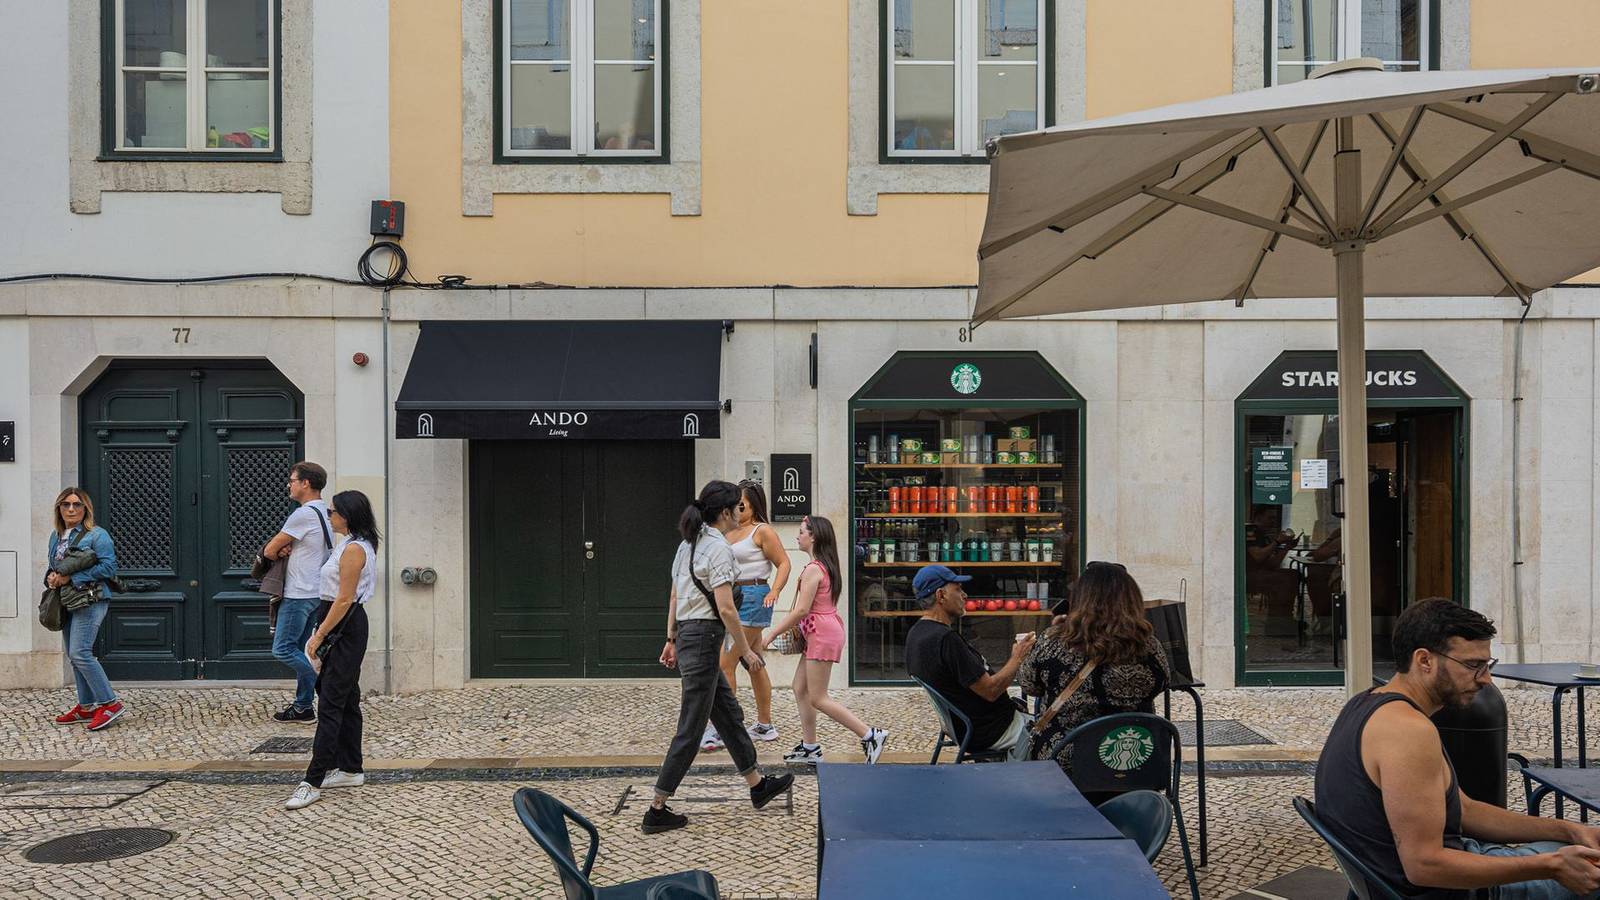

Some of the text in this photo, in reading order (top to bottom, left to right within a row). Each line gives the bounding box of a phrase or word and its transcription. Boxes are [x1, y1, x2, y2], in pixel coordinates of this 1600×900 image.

[172, 327, 191, 344] 77
[959, 327, 973, 343] 81
[1281, 370, 1417, 387] STARUCKS
[528, 411, 588, 426] ANDO
[777, 495, 806, 503] ANDO
